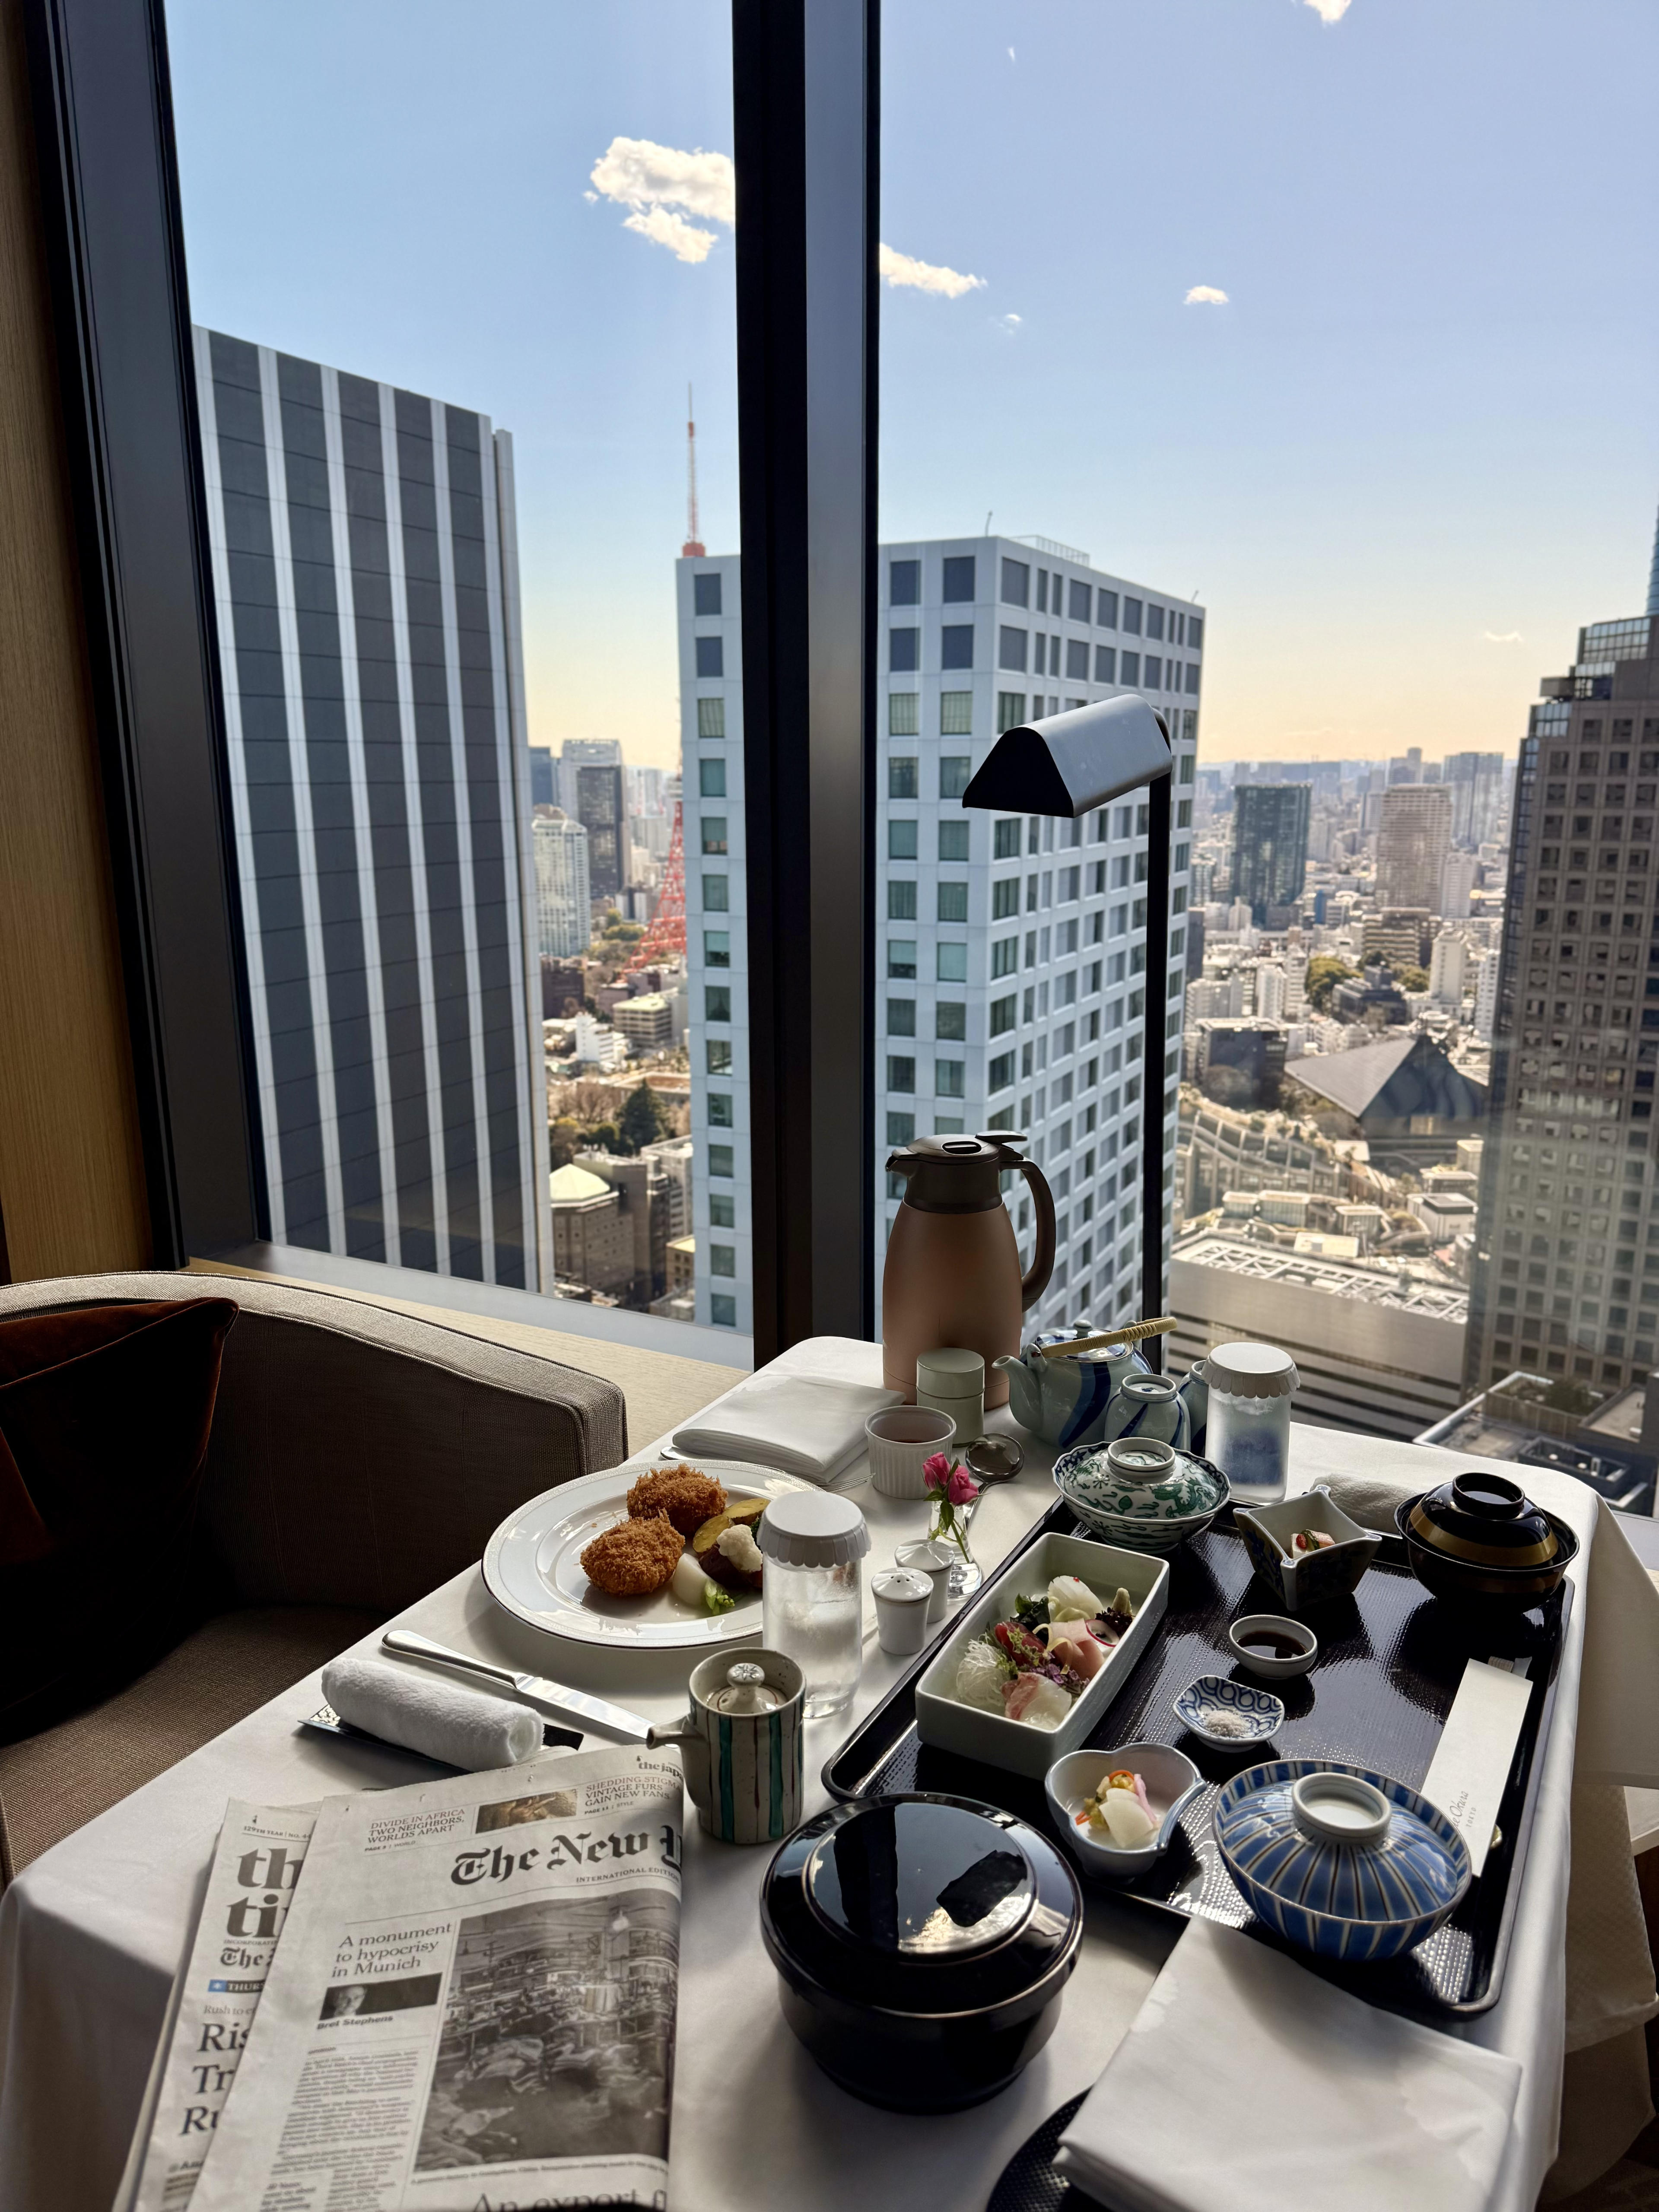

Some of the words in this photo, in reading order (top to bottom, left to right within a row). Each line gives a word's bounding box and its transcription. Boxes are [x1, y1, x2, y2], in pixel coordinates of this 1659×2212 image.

[638, 1761, 660, 1770] the
[585, 1784, 632, 1799] VINTAGE
[636, 1783, 663, 1791] FURS
[586, 1776, 641, 1792] SHEDDING
[585, 1794, 612, 1806] GAIN
[614, 1791, 640, 1799] NEW
[643, 1790, 670, 1800] FANS
[1449, 1790, 1469, 1817] Okura
[369, 1827, 395, 1836] TWO
[398, 1816, 465, 1833] NEIGHBORS,
[371, 1817, 409, 1830] DIVIDE
[411, 1815, 423, 1823] IN
[426, 1808, 465, 1821] AFRICA
[1465, 1807, 1476, 1827] TOKYO
[243, 1825, 265, 1834] 129TH
[368, 1831, 415, 1843] WORLDS
[417, 1824, 455, 1836] APART
[451, 1845, 541, 1885] The
[547, 1831, 650, 1871] New
[576, 1867, 647, 1884] INTERNATIONAL
[227, 1894, 289, 1938] ti
[339, 1936, 354, 1948] A
[359, 1923, 452, 1945] monument
[220, 1946, 264, 1969] The
[336, 1953, 352, 1963] to
[357, 1941, 439, 1962] hypocrisy
[332, 1967, 348, 1978] in
[354, 1956, 421, 1975] Munich
[203, 2005, 231, 2015] Rush
[317, 2020, 340, 2030] Bret
[343, 2015, 394, 2026] Stephens
